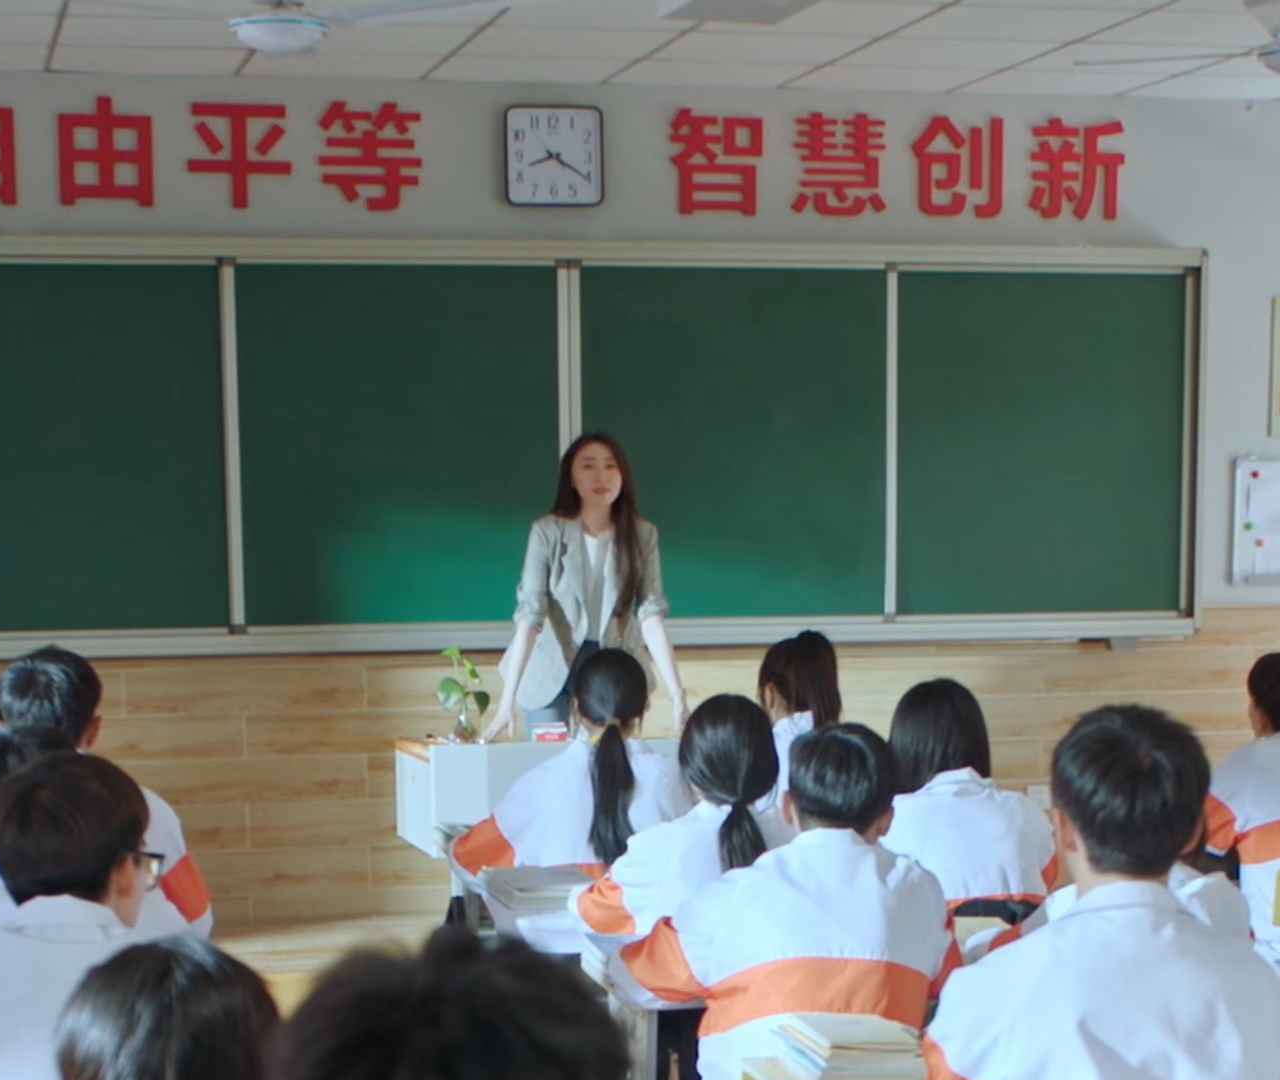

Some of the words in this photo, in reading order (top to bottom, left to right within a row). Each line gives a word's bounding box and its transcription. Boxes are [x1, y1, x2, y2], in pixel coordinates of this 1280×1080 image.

[547, 114, 560, 129] 12
[569, 115, 575, 131] 1
[583, 129, 592, 144] 2
[514, 149, 524, 164] 9
[584, 149, 592, 165] 3
[669, 107, 1126, 221] 智慧创新
[516, 169, 524, 184] 8
[531, 183, 539, 198] 7
[549, 183, 559, 198] 6
[567, 183, 577, 198] 5
